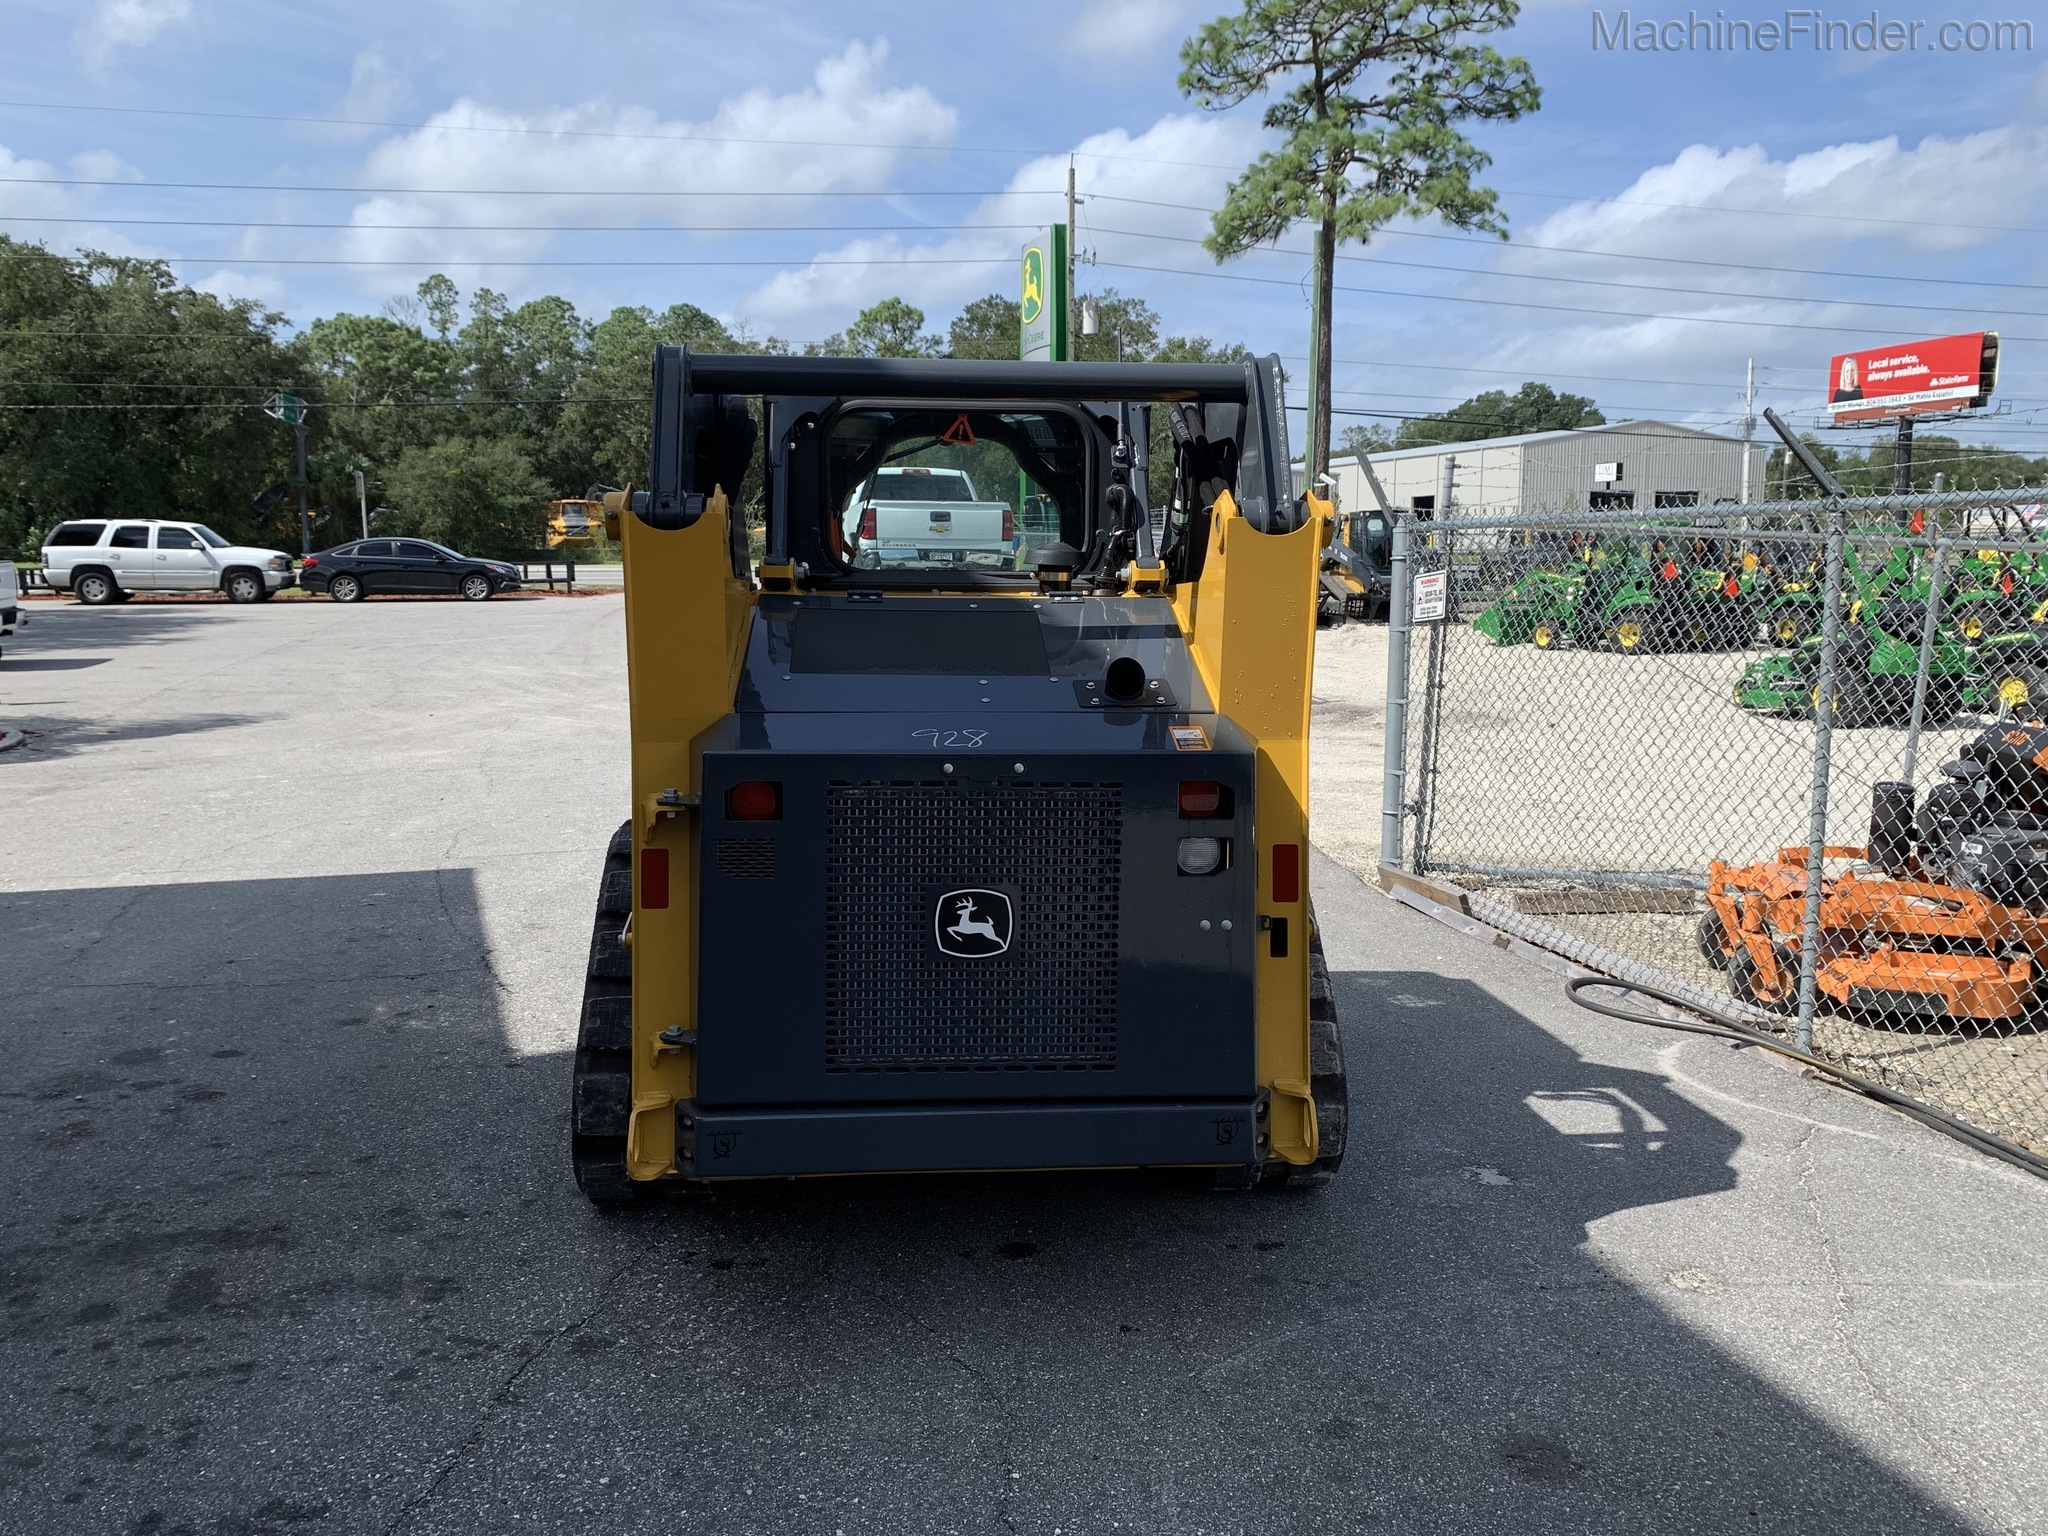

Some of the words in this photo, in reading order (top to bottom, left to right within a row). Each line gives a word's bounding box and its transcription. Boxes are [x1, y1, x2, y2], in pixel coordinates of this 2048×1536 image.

[1868, 357, 1888, 370] Local
[1890, 354, 1919, 367] service,
[1867, 371, 1892, 382] always
[1894, 364, 1930, 378] available.
[911, 728, 990, 748] 928
